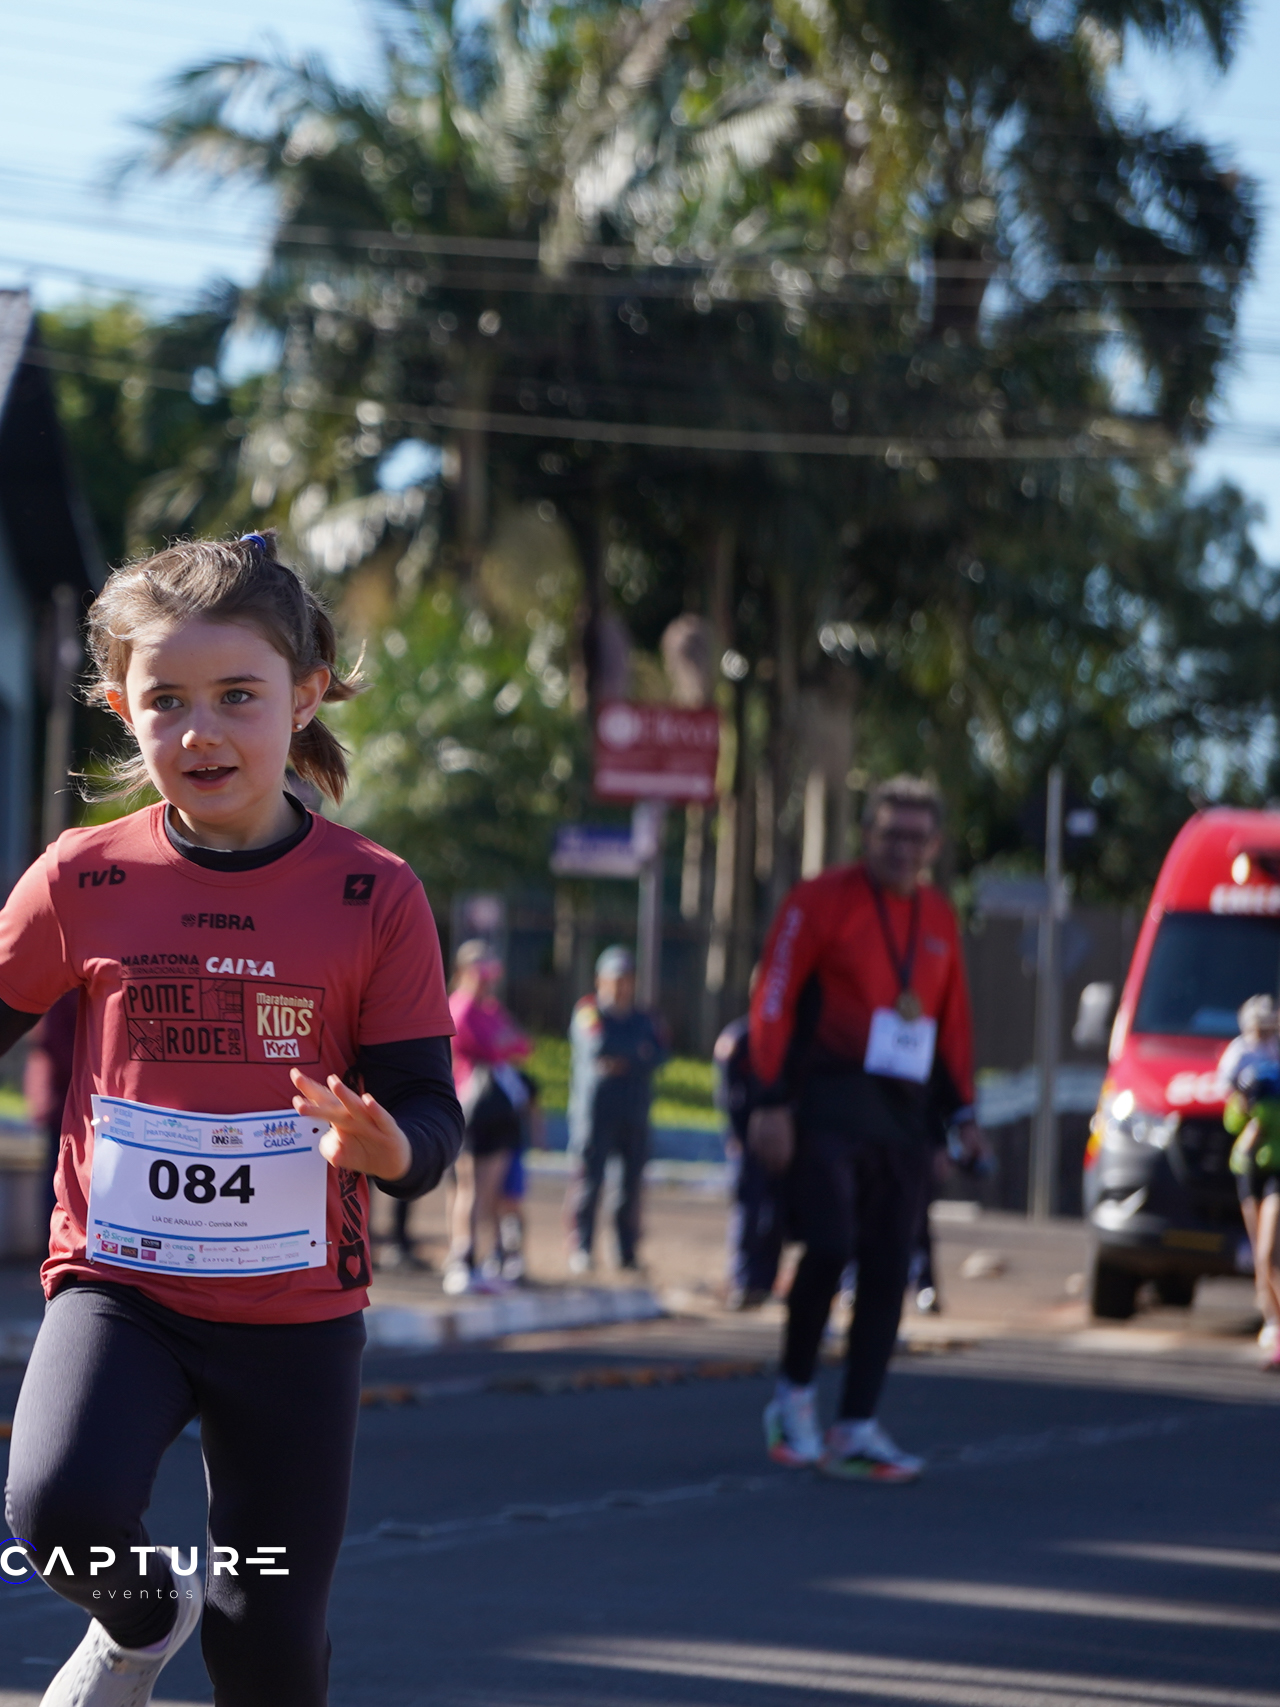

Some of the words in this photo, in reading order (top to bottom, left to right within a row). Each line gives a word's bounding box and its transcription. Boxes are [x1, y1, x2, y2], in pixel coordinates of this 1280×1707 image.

[78, 865, 126, 888] rvb
[197, 913, 256, 931] FIBRA
[121, 954, 200, 966] MARATONA
[206, 956, 275, 977] CAIXA
[188, 967, 200, 975] DE
[127, 984, 195, 1013] POME
[257, 1005, 313, 1036] KIDS
[166, 1026, 227, 1055] RODE
[227, 1028, 240, 1041] 20
[228, 1042, 241, 1055] 25
[211, 1135, 230, 1145] ONG
[263, 1137, 296, 1149] CAUSA
[148, 1159, 255, 1204] 084
[151, 1215, 162, 1223] LIA
[163, 1216, 173, 1225] DE
[208, 1220, 232, 1228] Corrida
[233, 1220, 248, 1228] Kids
[111, 1232, 135, 1244] Sicredi
